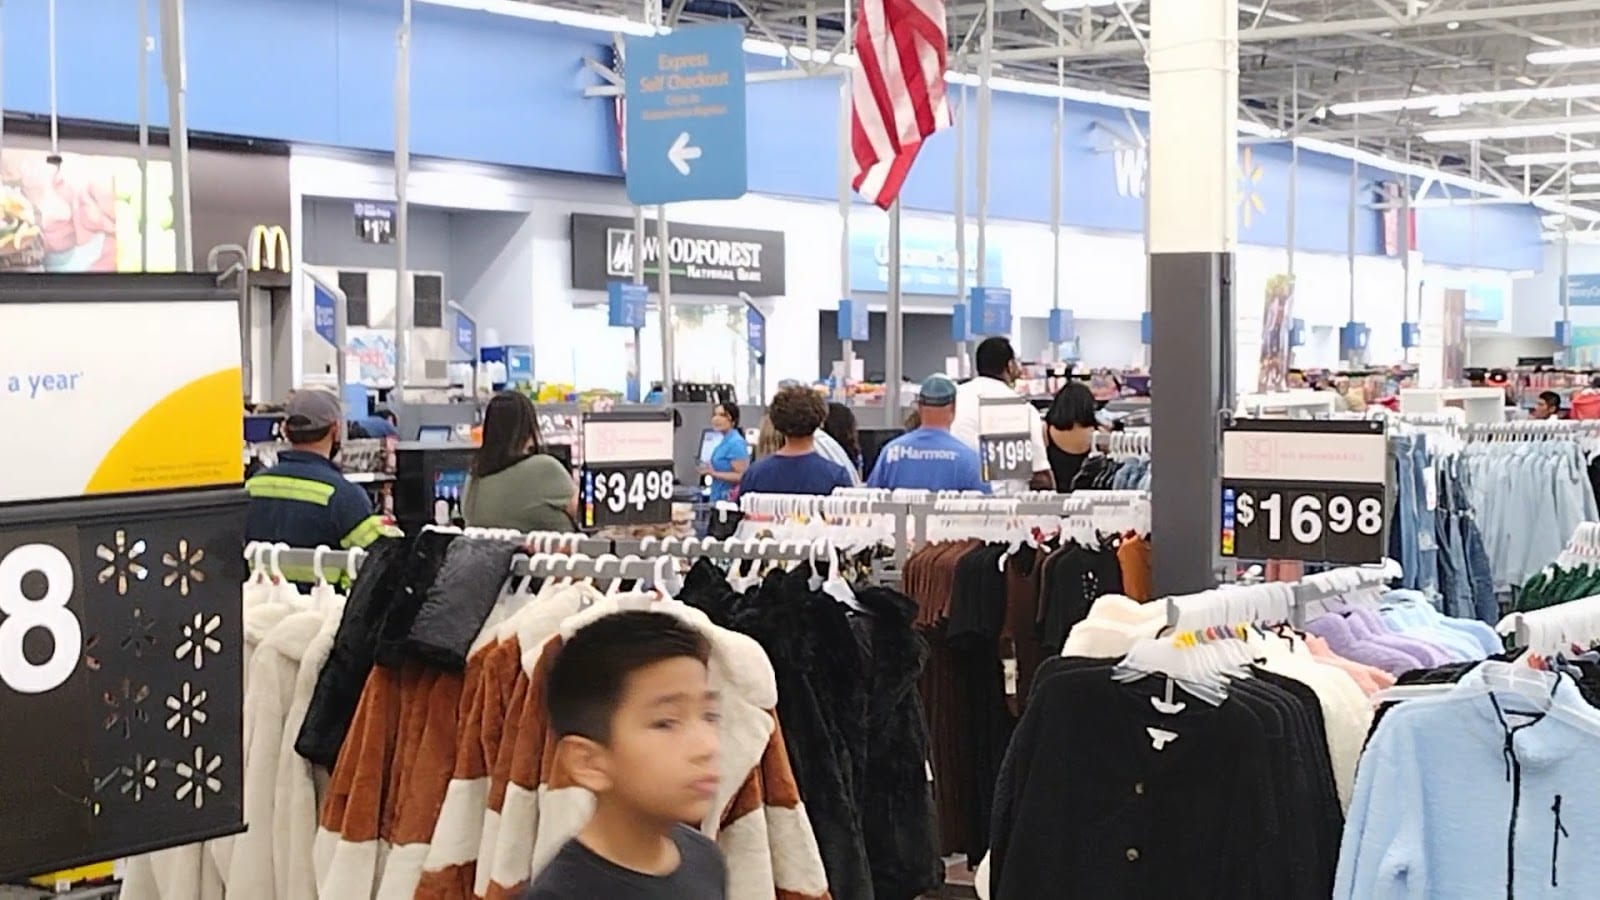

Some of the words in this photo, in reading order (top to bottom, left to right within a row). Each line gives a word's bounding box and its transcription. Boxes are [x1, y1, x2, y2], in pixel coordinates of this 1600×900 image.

[640, 76, 664, 93] Self
[667, 72, 728, 89] Checkout
[642, 236, 762, 267] WODFOREST
[7, 375, 20, 392] a
[594, 470, 674, 512] $3498
[1236, 492, 1382, 544] $1698
